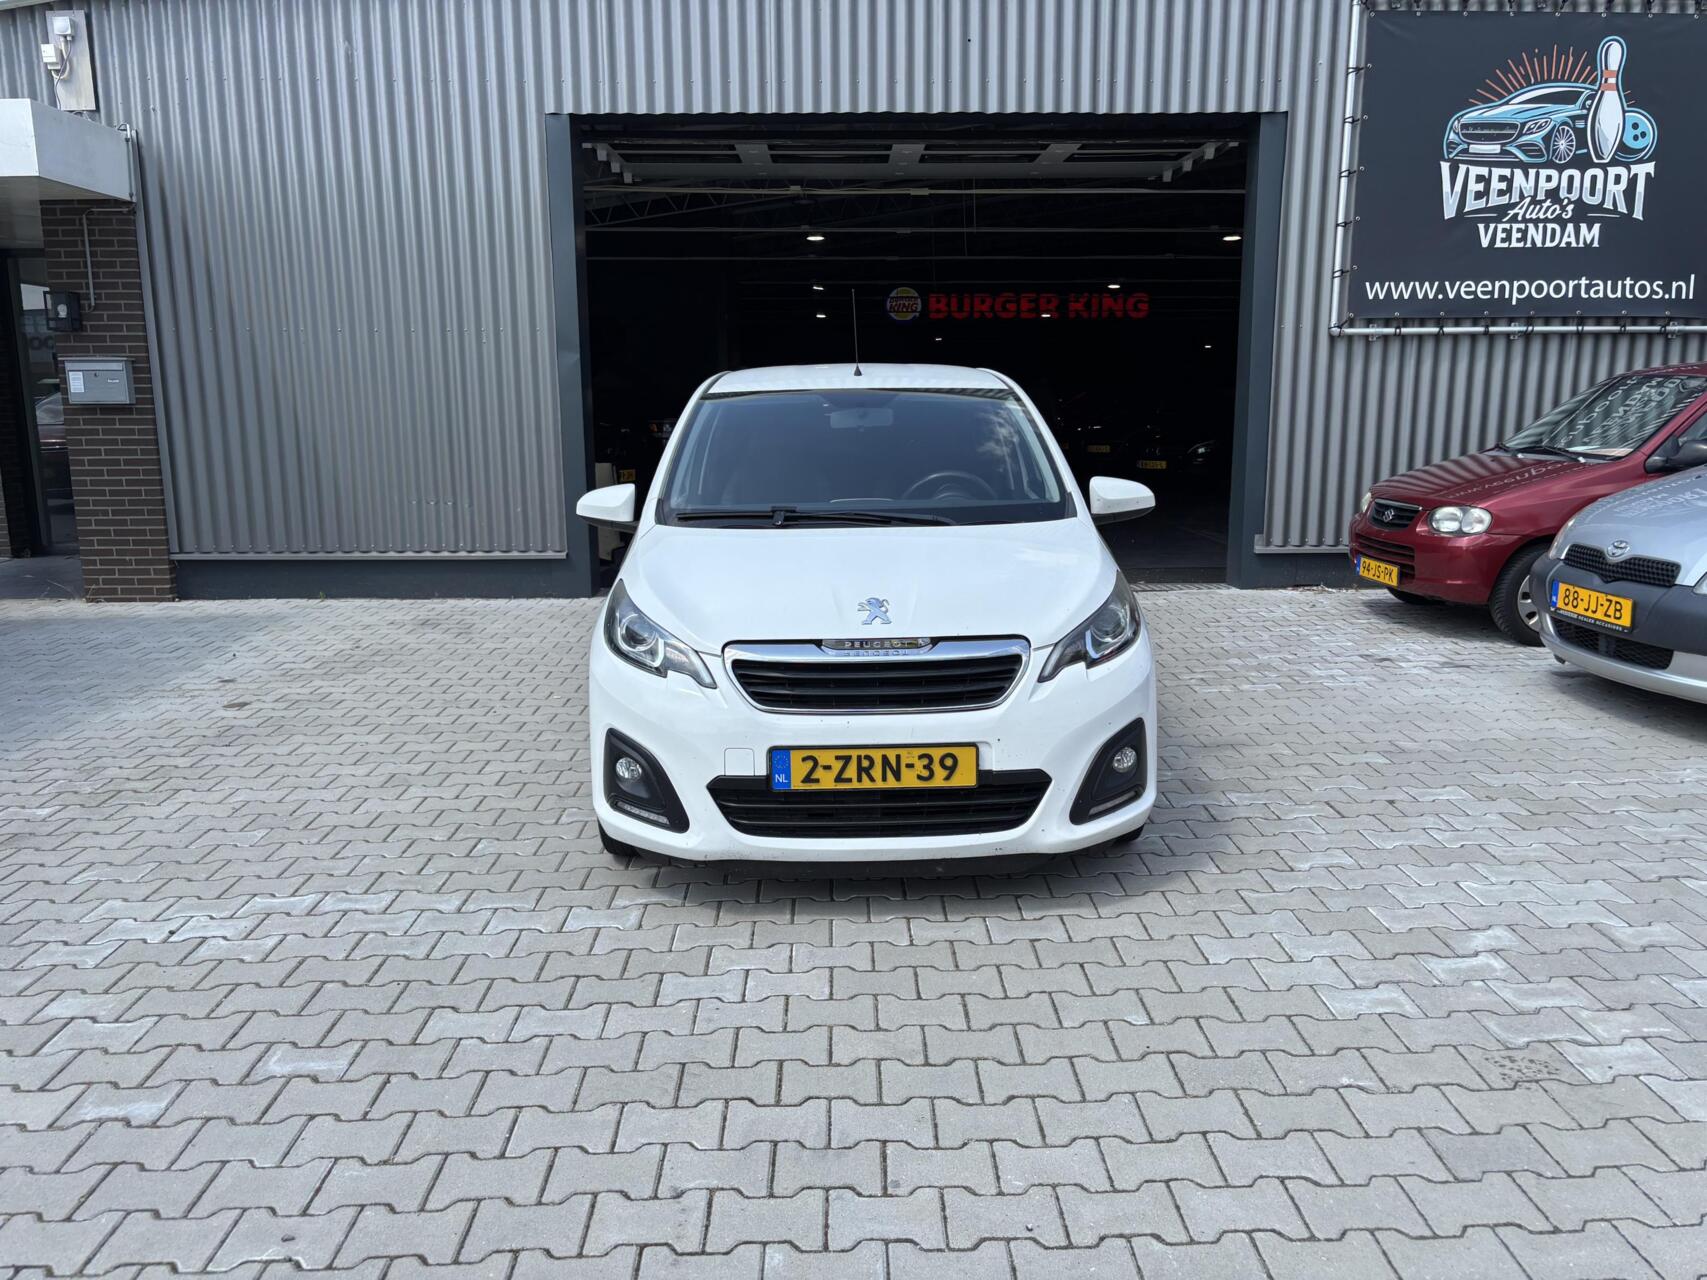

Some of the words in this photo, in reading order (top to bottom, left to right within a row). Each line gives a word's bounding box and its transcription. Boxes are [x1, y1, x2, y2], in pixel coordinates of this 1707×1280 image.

[1440, 161, 1656, 221] VEENPOORT
[1502, 196, 1575, 222] Auto's
[1477, 223, 1602, 248] VEENDAM
[1365, 274, 1696, 305] www.veenpoortautos.nl
[928, 293, 1060, 319] BURGER
[1068, 293, 1150, 319] KING
[1362, 560, 1394, 583] 94-JS-PK
[1563, 588, 1623, 620] 88-JJ-ZB
[844, 640, 910, 648] PEUGEOT
[775, 774, 789, 783] NL
[800, 752, 959, 784] 2-ZRN-39
